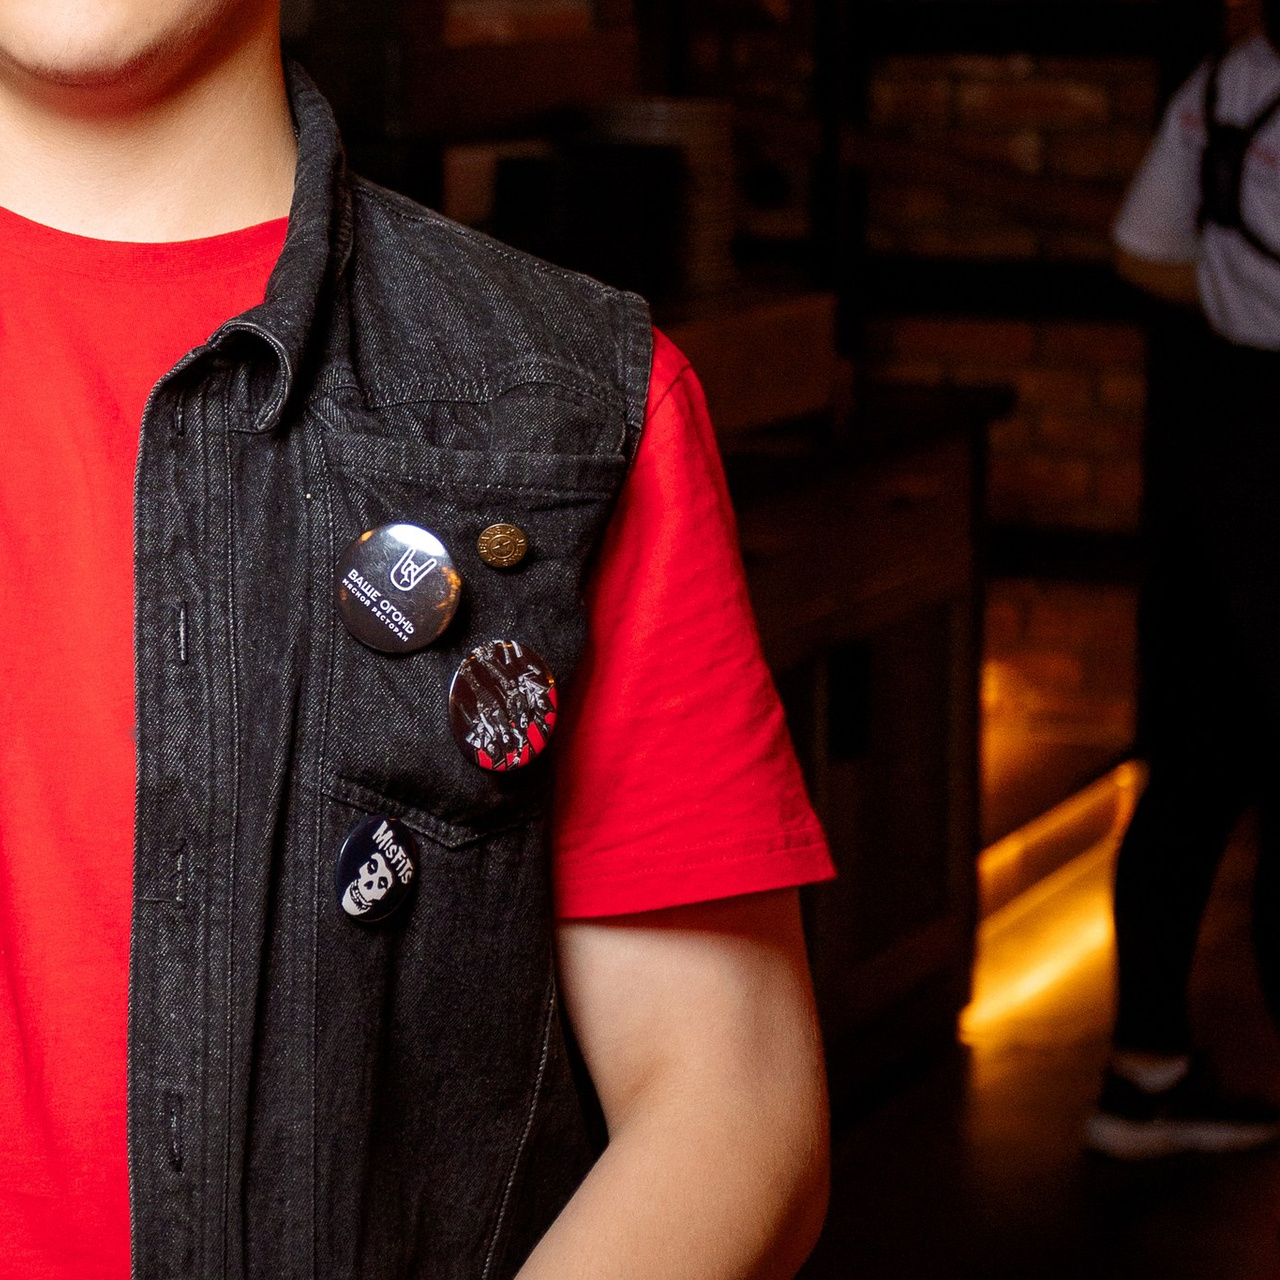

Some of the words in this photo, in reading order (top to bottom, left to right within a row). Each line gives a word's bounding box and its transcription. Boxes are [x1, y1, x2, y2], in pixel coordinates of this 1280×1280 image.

[342, 578, 371, 607] МЯСНОЙ
[371, 606, 409, 642] РЕСТОРАН
[348, 569, 381, 602] ВАЩЕ
[380, 600, 414, 634] ОГОНЬ
